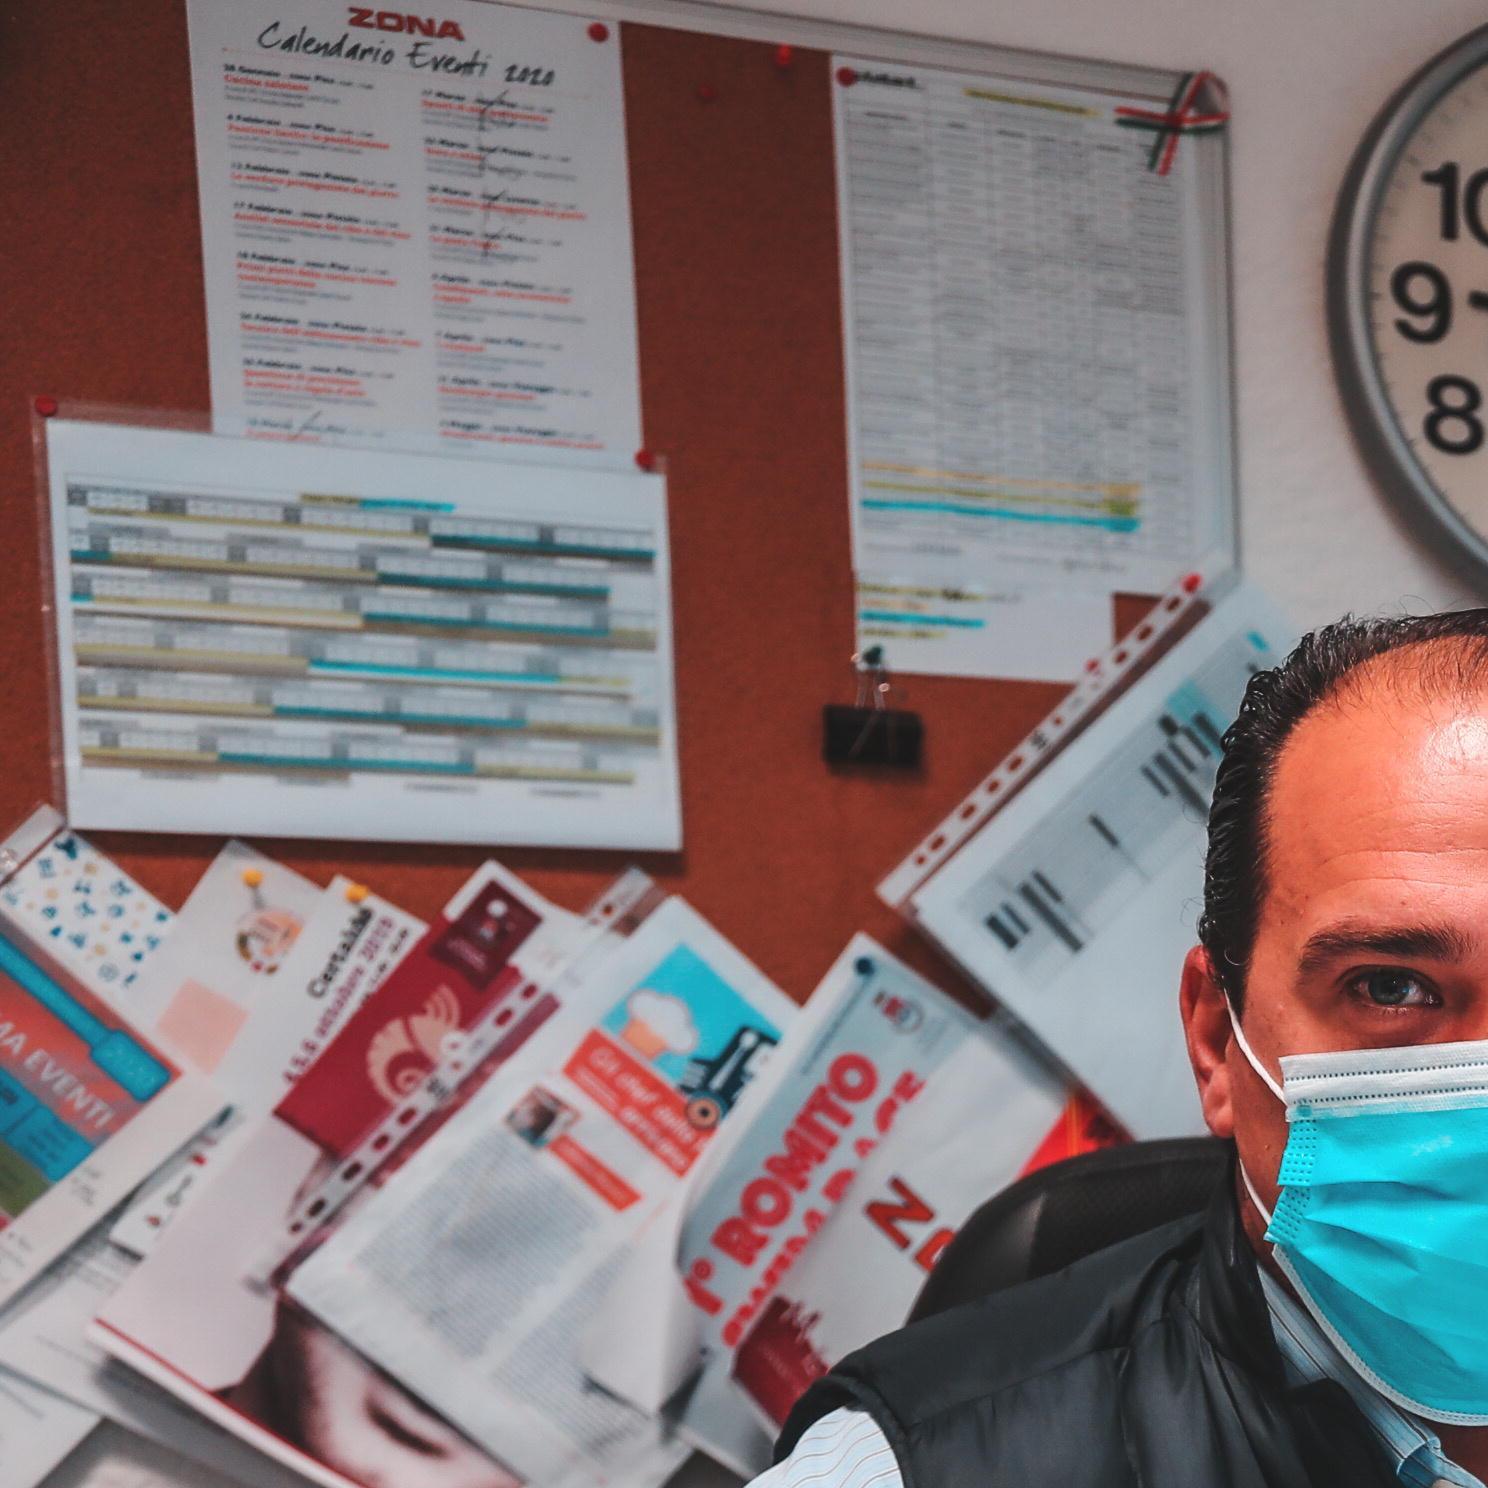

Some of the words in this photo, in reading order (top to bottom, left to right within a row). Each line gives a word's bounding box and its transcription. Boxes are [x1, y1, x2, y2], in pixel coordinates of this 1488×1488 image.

[258, 21, 395, 66] Calendario
[407, 41, 491, 77] Eventi
[504, 63, 556, 87] 2020
[348, 7, 466, 41] ZONA
[1389, 261, 1453, 345] 9
[1422, 374, 1485, 455] 8
[24, 1048, 116, 1130] EVENTI
[710, 1051, 878, 1268] ROMITO
